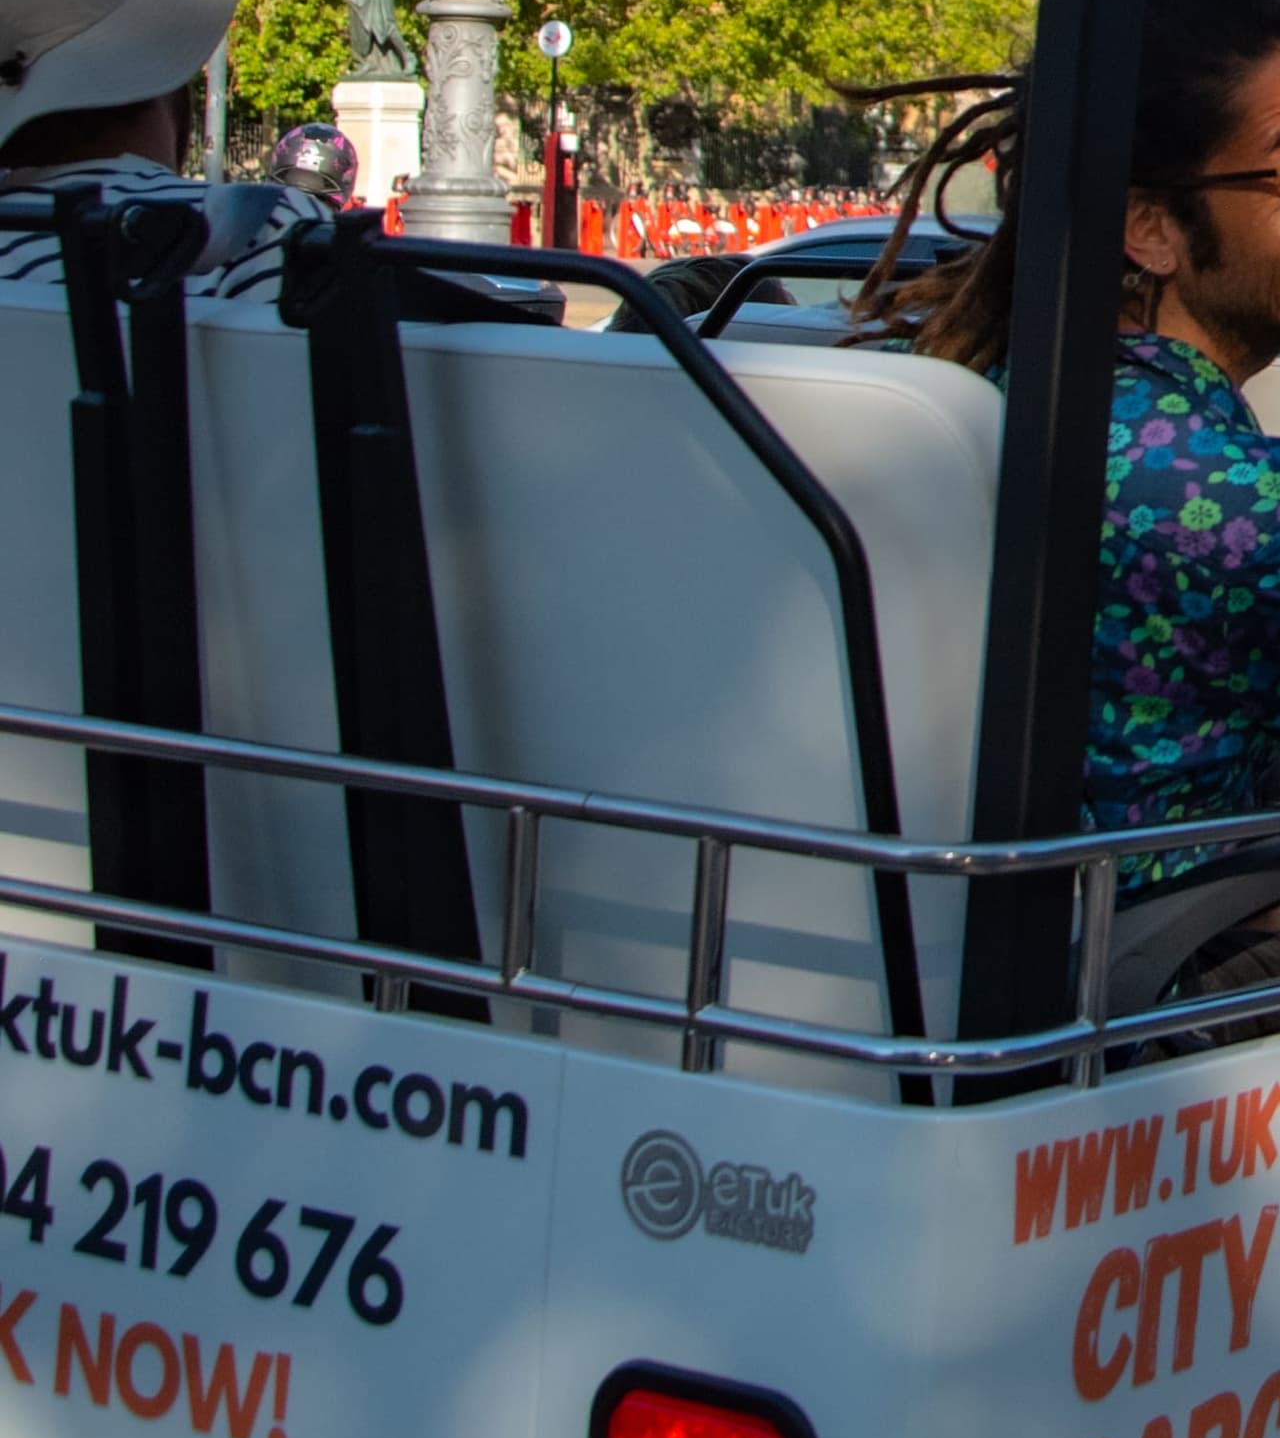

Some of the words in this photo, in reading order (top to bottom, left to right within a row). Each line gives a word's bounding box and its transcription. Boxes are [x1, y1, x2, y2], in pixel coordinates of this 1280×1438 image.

[0, 1142, 54, 1244] 4
[73, 1158, 218, 1278] 219
[236, 1198, 405, 1326] 676
[710, 1163, 814, 1222] eTuk
[1072, 1205, 1279, 1403] CITY
